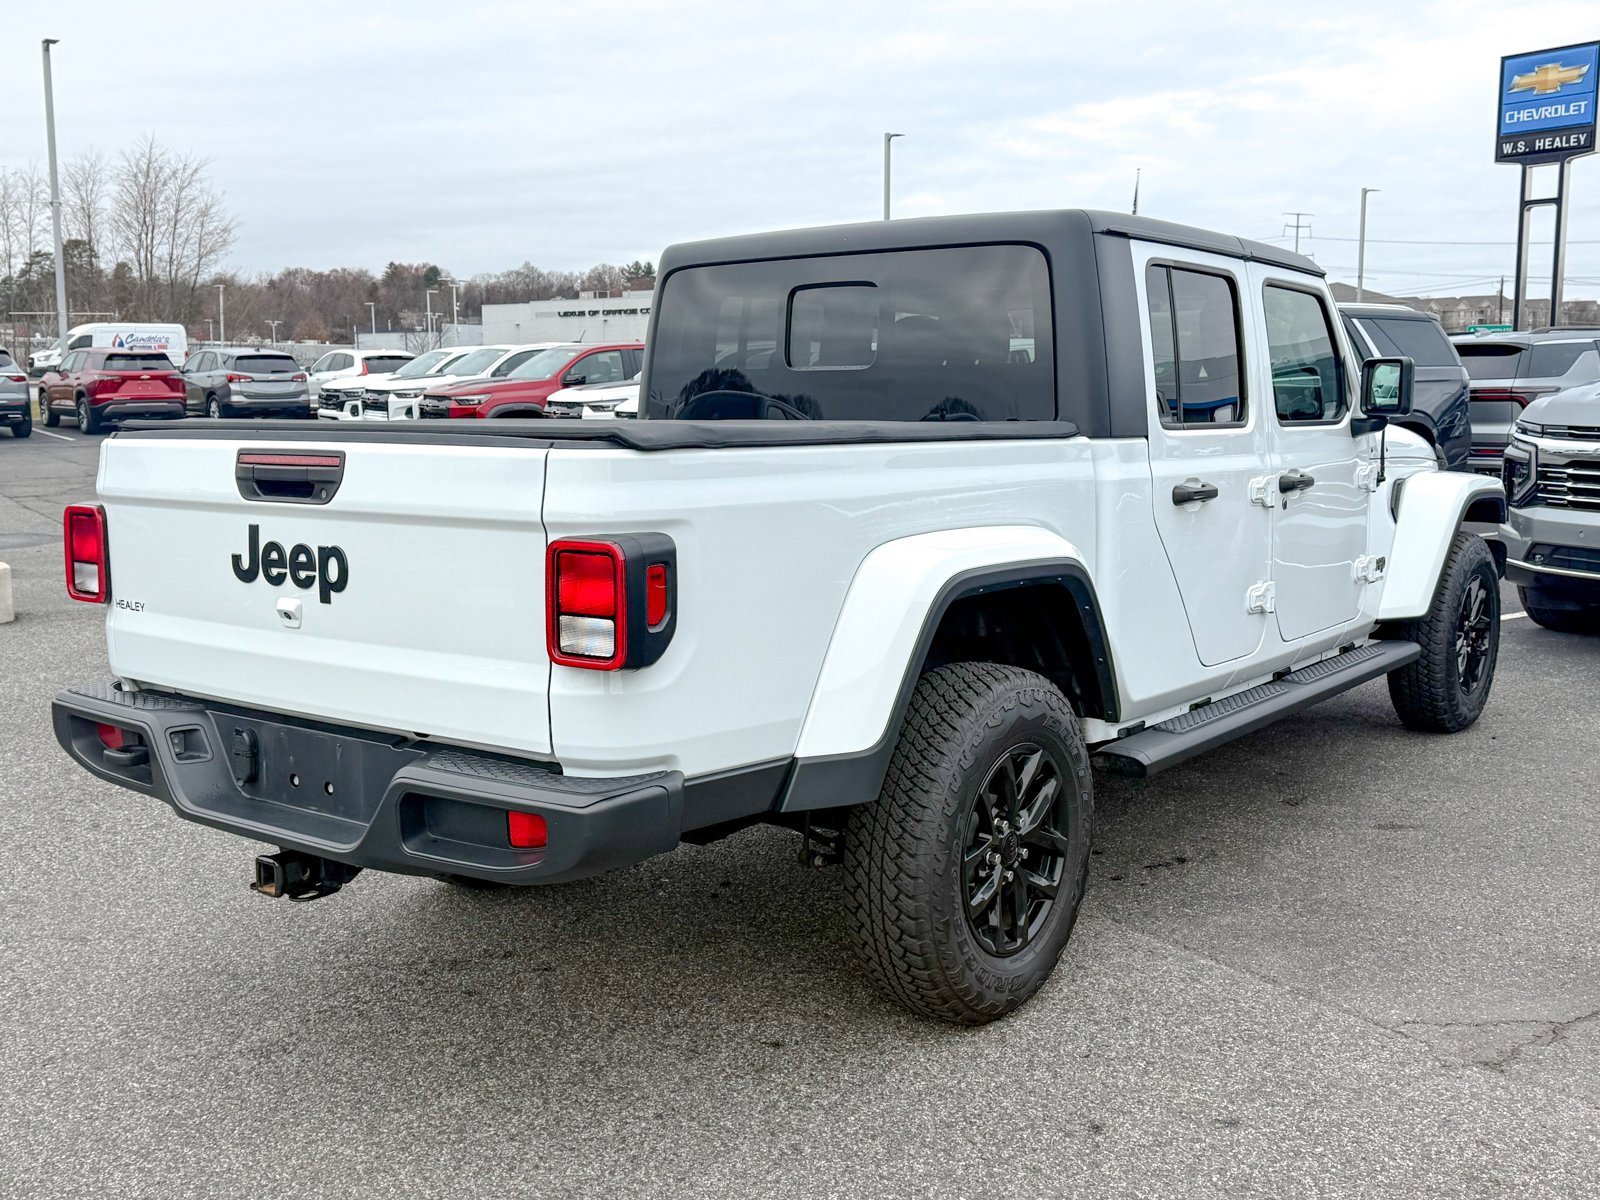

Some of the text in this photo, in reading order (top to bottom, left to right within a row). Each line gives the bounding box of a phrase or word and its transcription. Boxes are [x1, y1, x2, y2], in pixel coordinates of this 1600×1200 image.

[1505, 101, 1588, 124] CHEVROLET
[1502, 133, 1588, 154] W.S. HEALEY
[602, 308, 638, 316] ORANGE
[231, 523, 349, 605] Jeep
[115, 599, 145, 612] HEALEY
